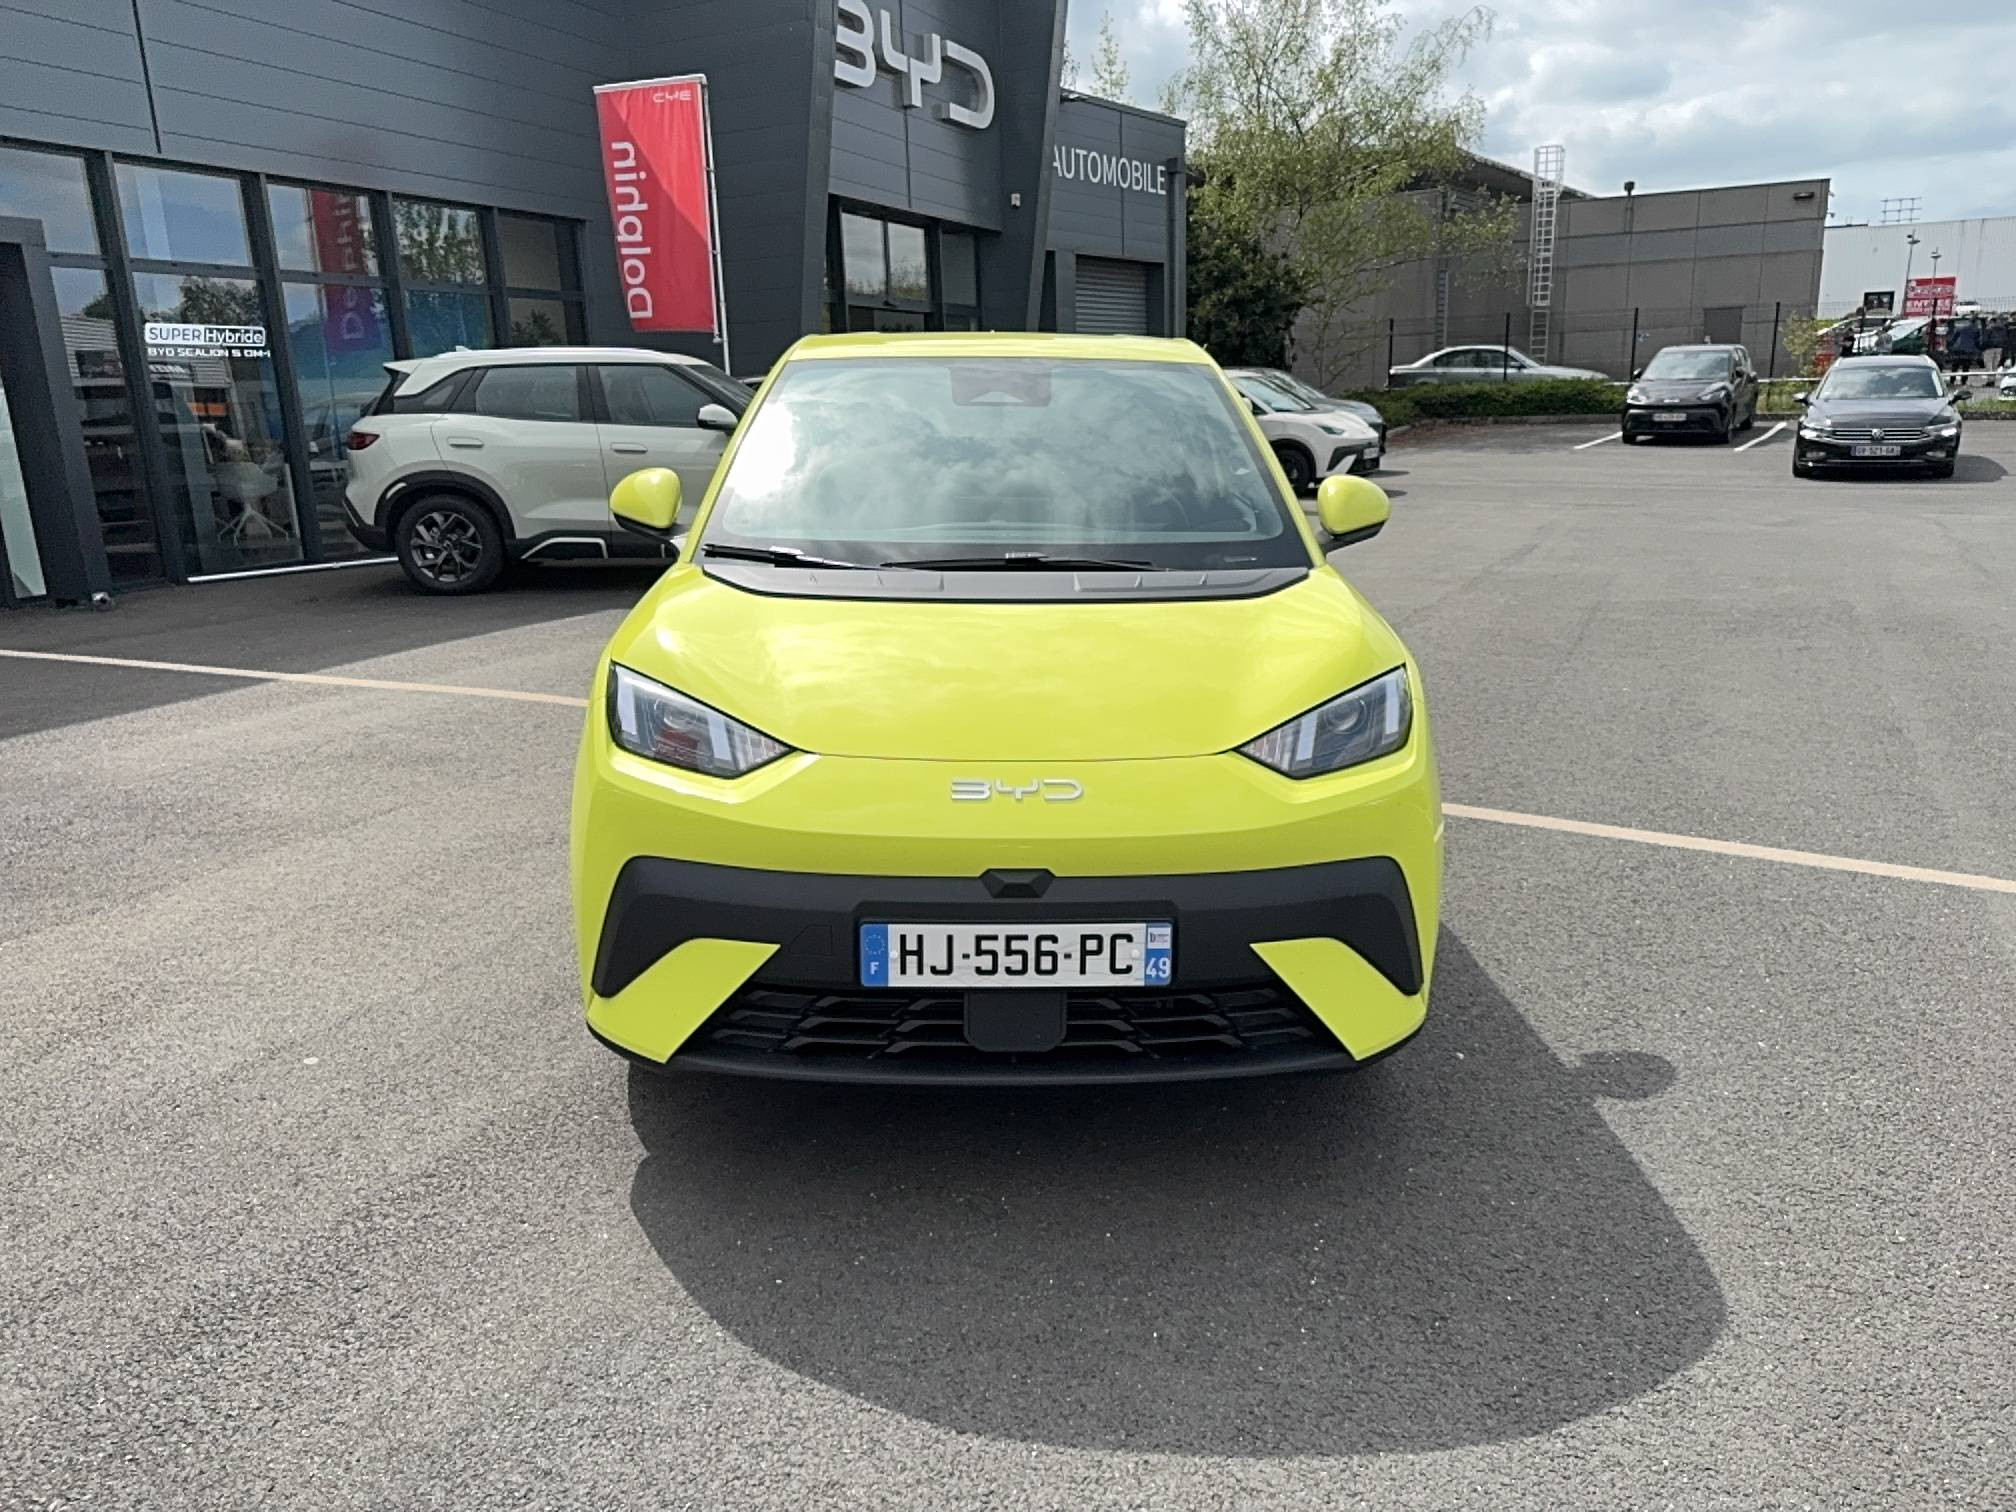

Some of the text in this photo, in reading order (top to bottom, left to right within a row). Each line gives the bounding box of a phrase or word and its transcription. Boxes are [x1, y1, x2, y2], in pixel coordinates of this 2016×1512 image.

[834, 0, 995, 129] BYD
[149, 327, 263, 345] SUPER Hybride
[147, 347, 175, 357] BYD
[178, 347, 229, 358] SEALION
[951, 778, 1083, 801] BYD
[899, 934, 1133, 976] HJ-556-PC
[870, 962, 879, 975] F
[1146, 957, 1170, 978] 49
